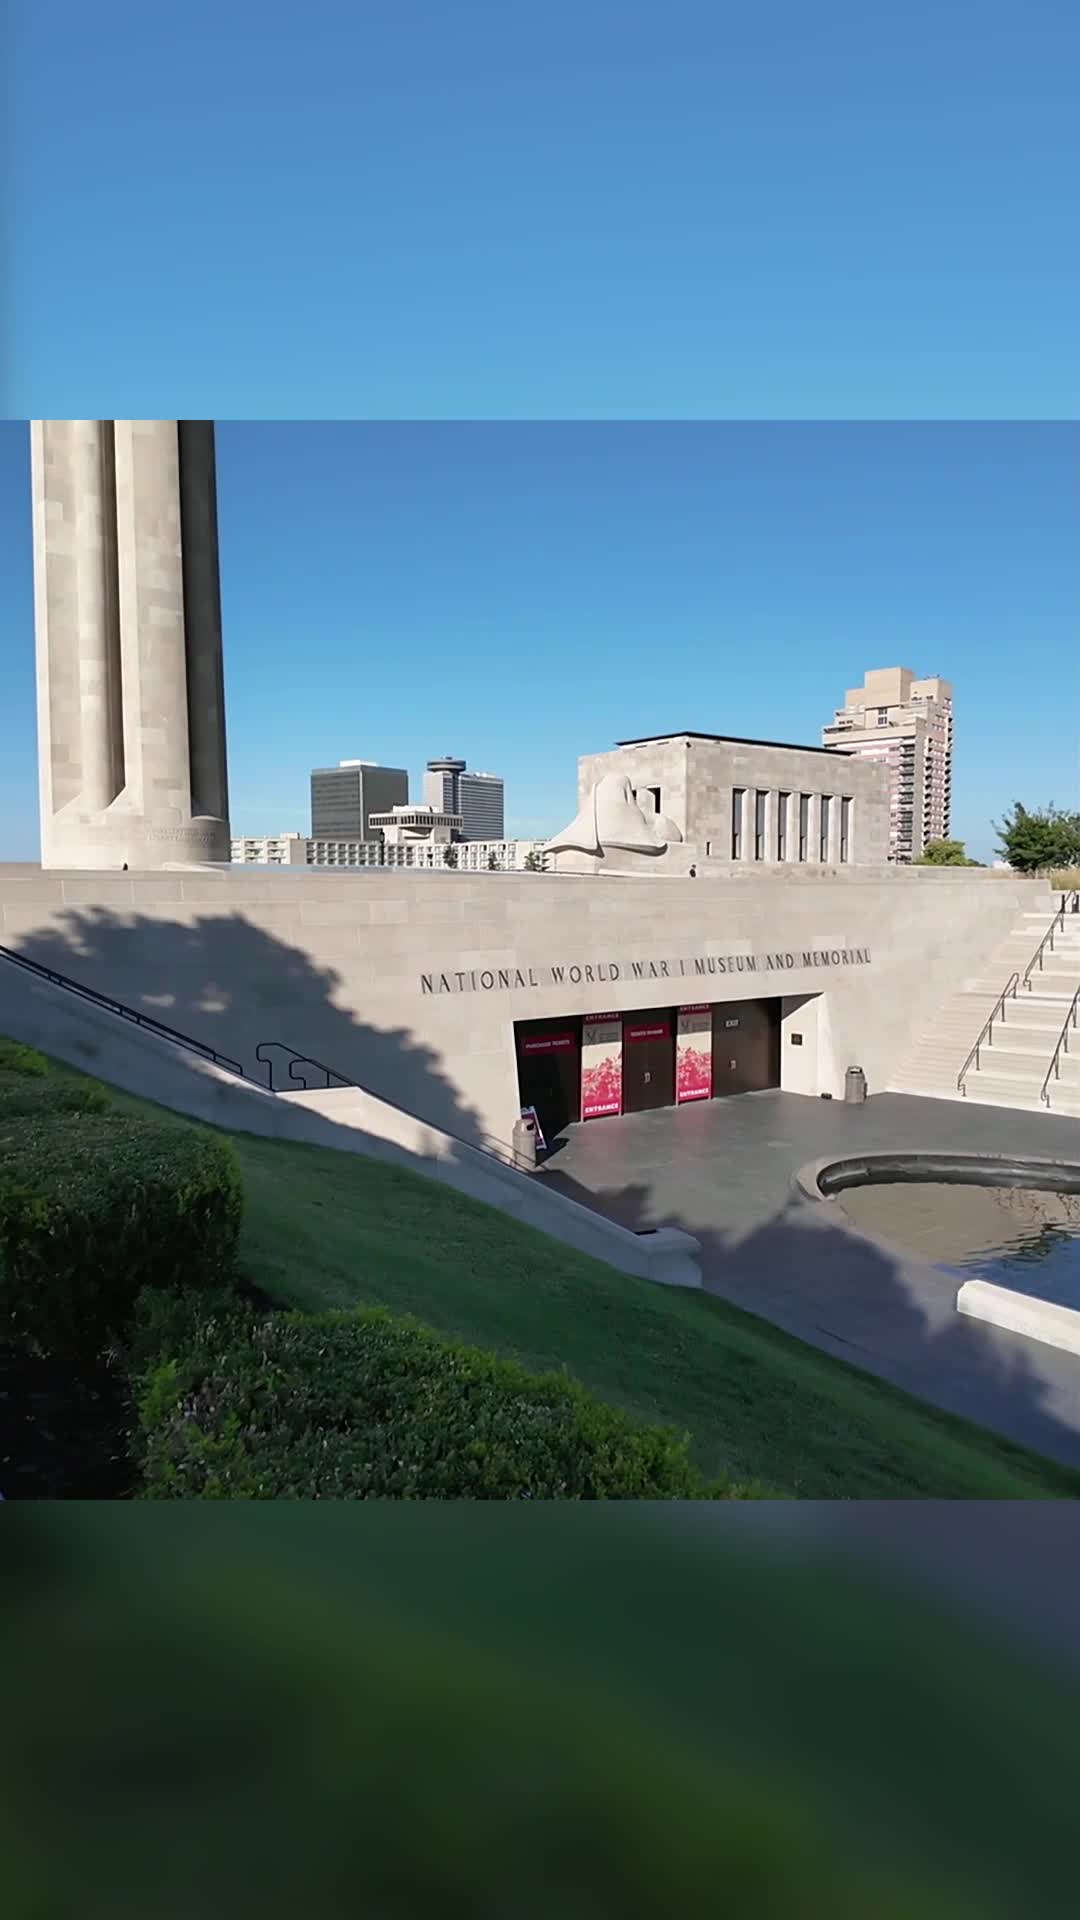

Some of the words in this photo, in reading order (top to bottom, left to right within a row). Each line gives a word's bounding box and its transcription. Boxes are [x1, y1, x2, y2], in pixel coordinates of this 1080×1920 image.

[421, 968, 538, 994] NATIONAL
[551, 963, 619, 984] WORLD
[631, 960, 670, 978] WAR
[679, 959, 685, 976] I
[694, 955, 756, 976] MUSEUM
[766, 953, 795, 970] AND
[802, 948, 871, 968] MEMORIAL
[585, 1012, 619, 1021] ENTRANCE
[680, 1087, 709, 1098] ENTRANCE
[585, 1102, 619, 1113] ENTRANCE
